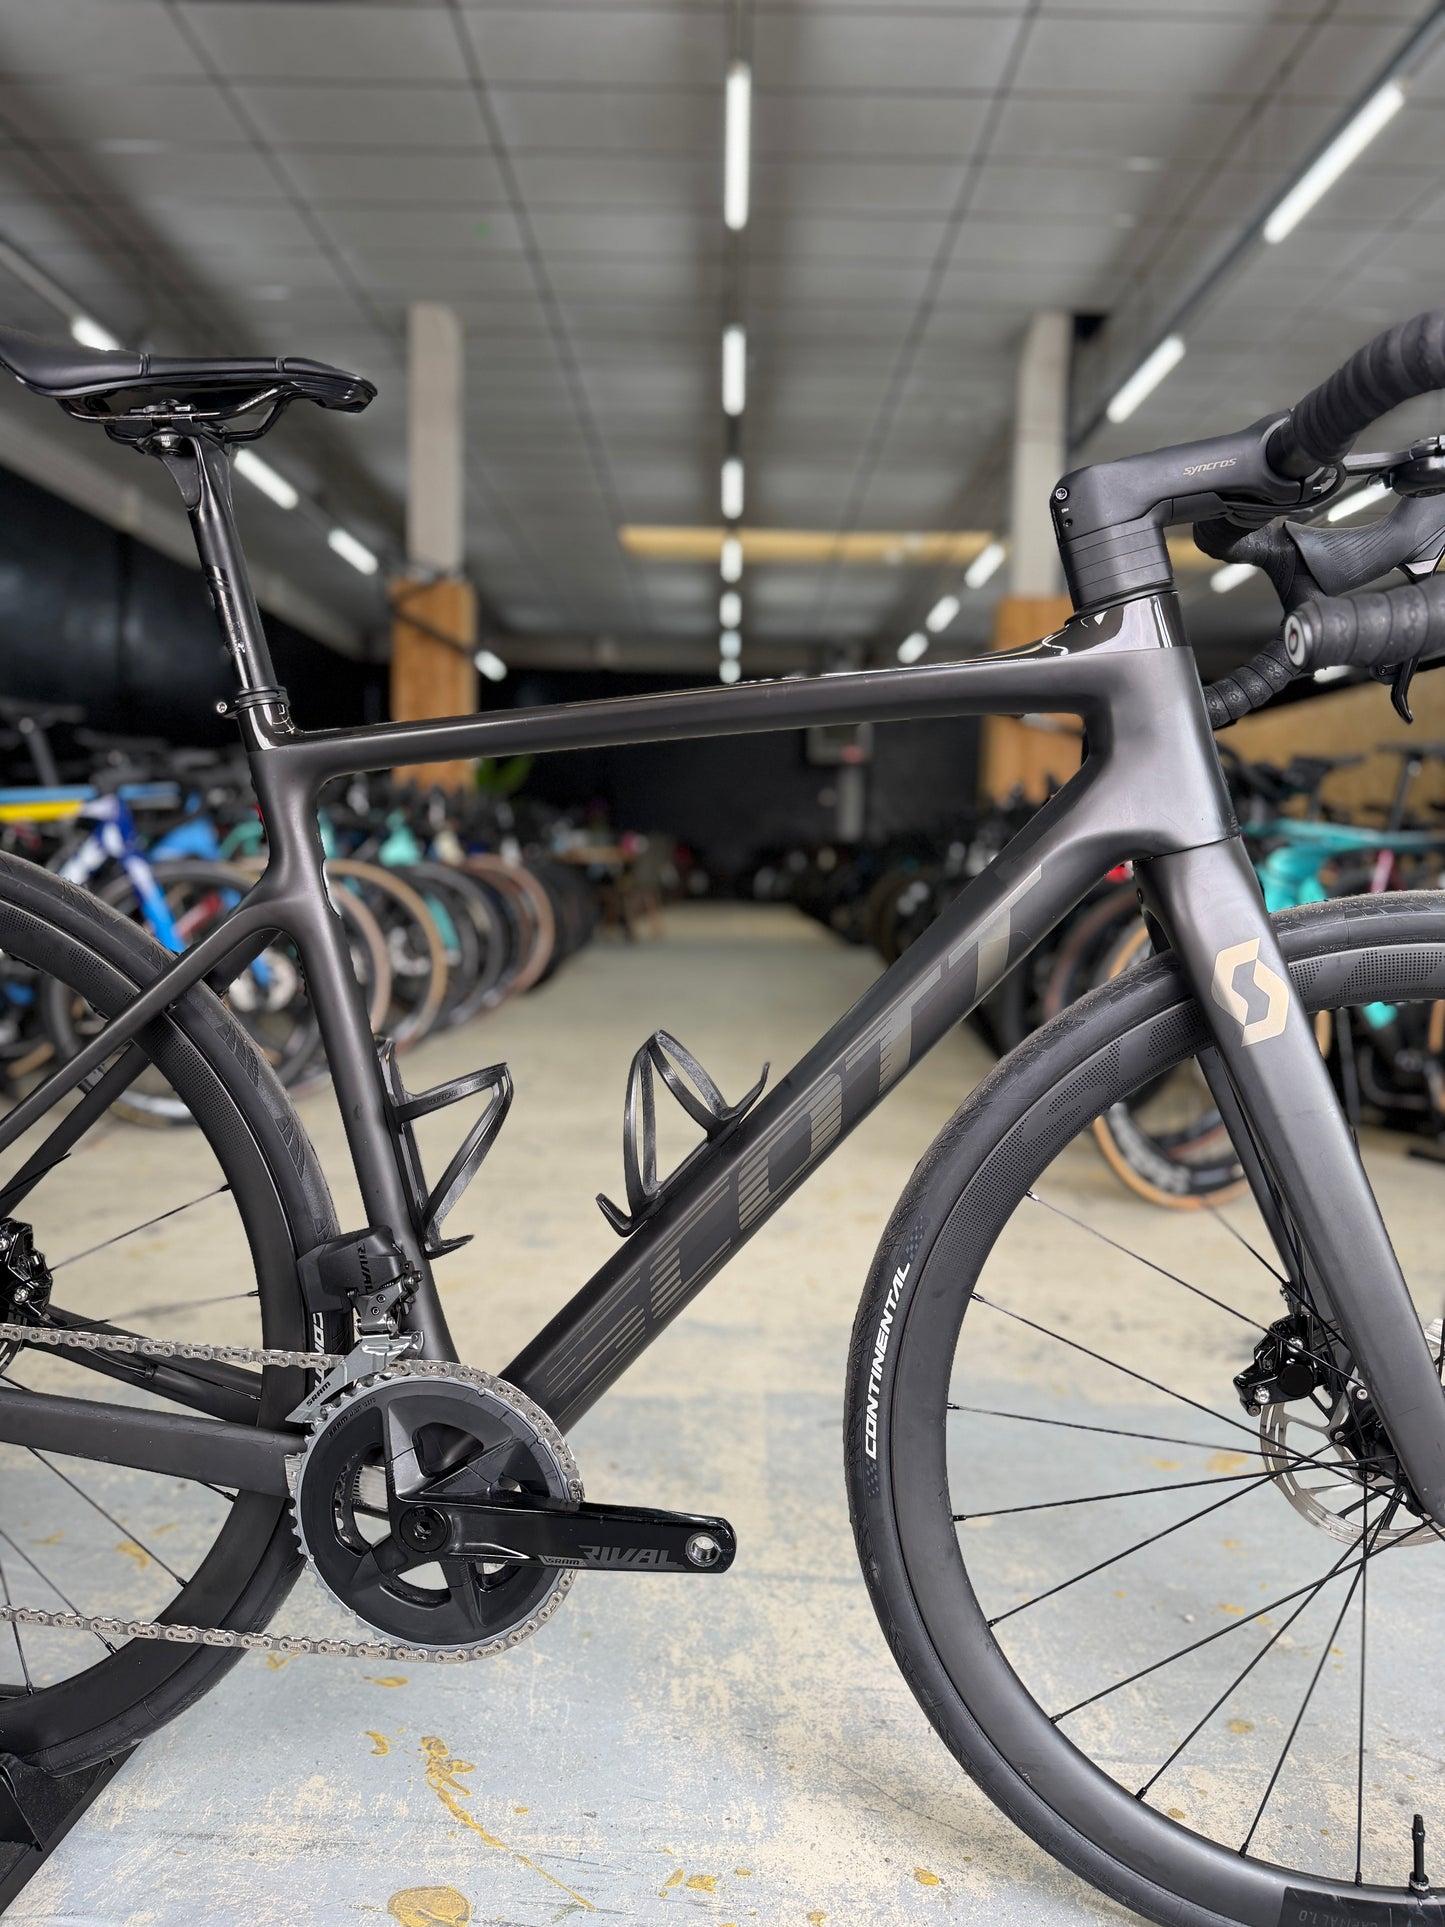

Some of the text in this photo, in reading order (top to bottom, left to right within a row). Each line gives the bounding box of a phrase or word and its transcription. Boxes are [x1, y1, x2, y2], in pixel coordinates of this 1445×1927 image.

[1183, 457, 1238, 476] syncros
[546, 864, 1042, 1421] SCOTT
[358, 1242, 374, 1292] RIVAL
[865, 1262, 911, 1460] CONTINENTAL
[306, 1381, 331, 1407] SRAM
[547, 1544, 681, 1568] SRAM RIVAL
